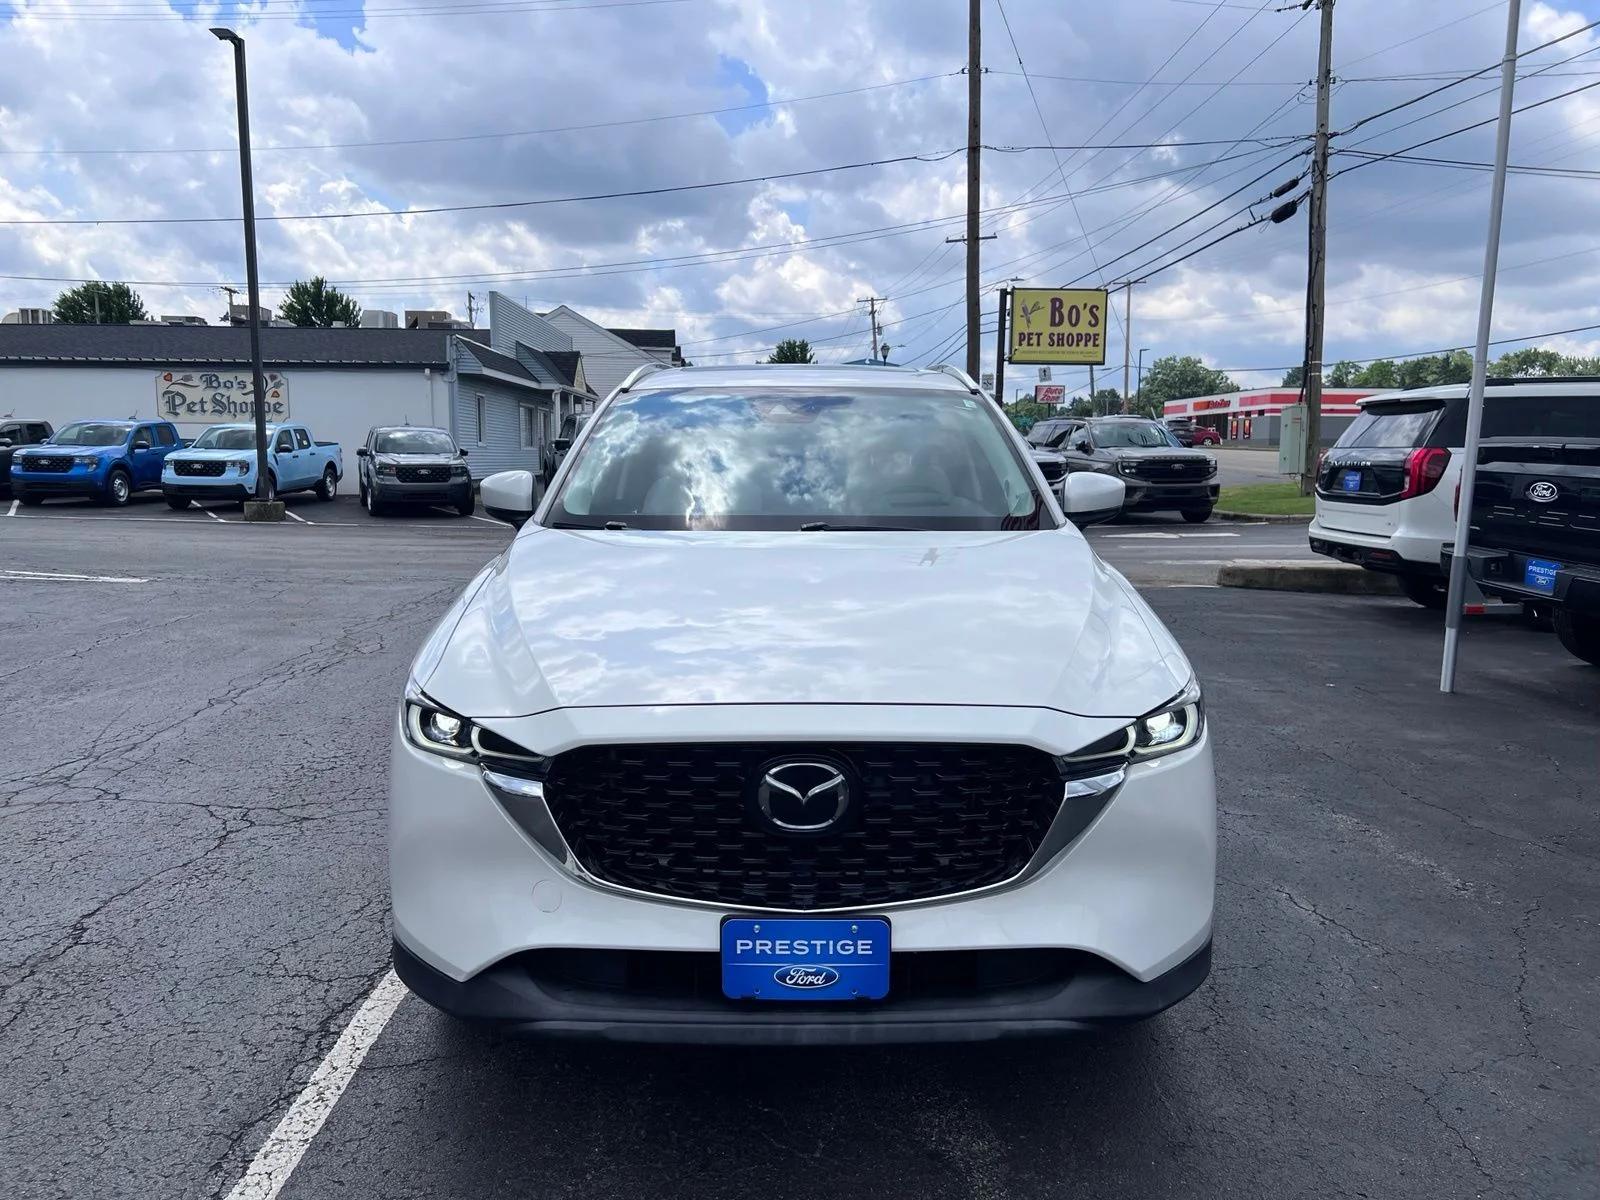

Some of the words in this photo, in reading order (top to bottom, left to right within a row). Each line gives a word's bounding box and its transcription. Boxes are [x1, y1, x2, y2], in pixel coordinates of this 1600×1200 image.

[1050, 297, 1100, 328] Bo's
[1018, 332, 1043, 347] PET
[1048, 332, 1100, 347] SHOPPE
[200, 373, 247, 390] Bo's
[162, 390, 209, 417] Pet
[1533, 484, 1552, 497] Ford
[736, 939, 873, 955] PRESTIGE
[786, 967, 826, 985] Ford
